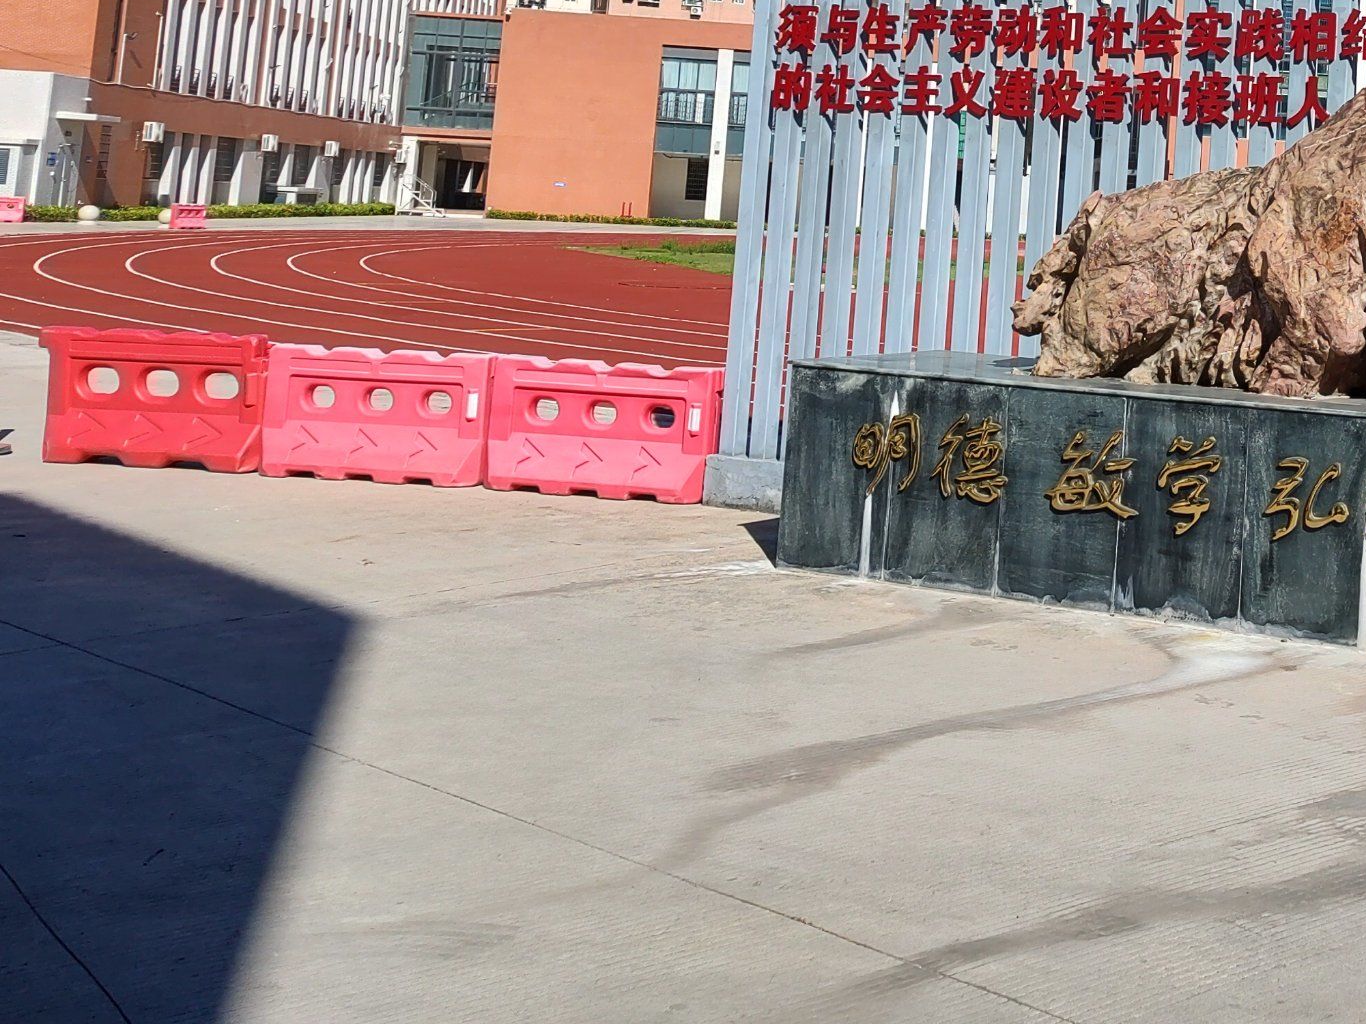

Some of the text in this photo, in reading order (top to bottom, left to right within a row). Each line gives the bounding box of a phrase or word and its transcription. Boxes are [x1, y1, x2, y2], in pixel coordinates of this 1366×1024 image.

[771, 63, 1330, 127] 的社会主义建设者和接班人
[852, 411, 1008, 504] 明德
